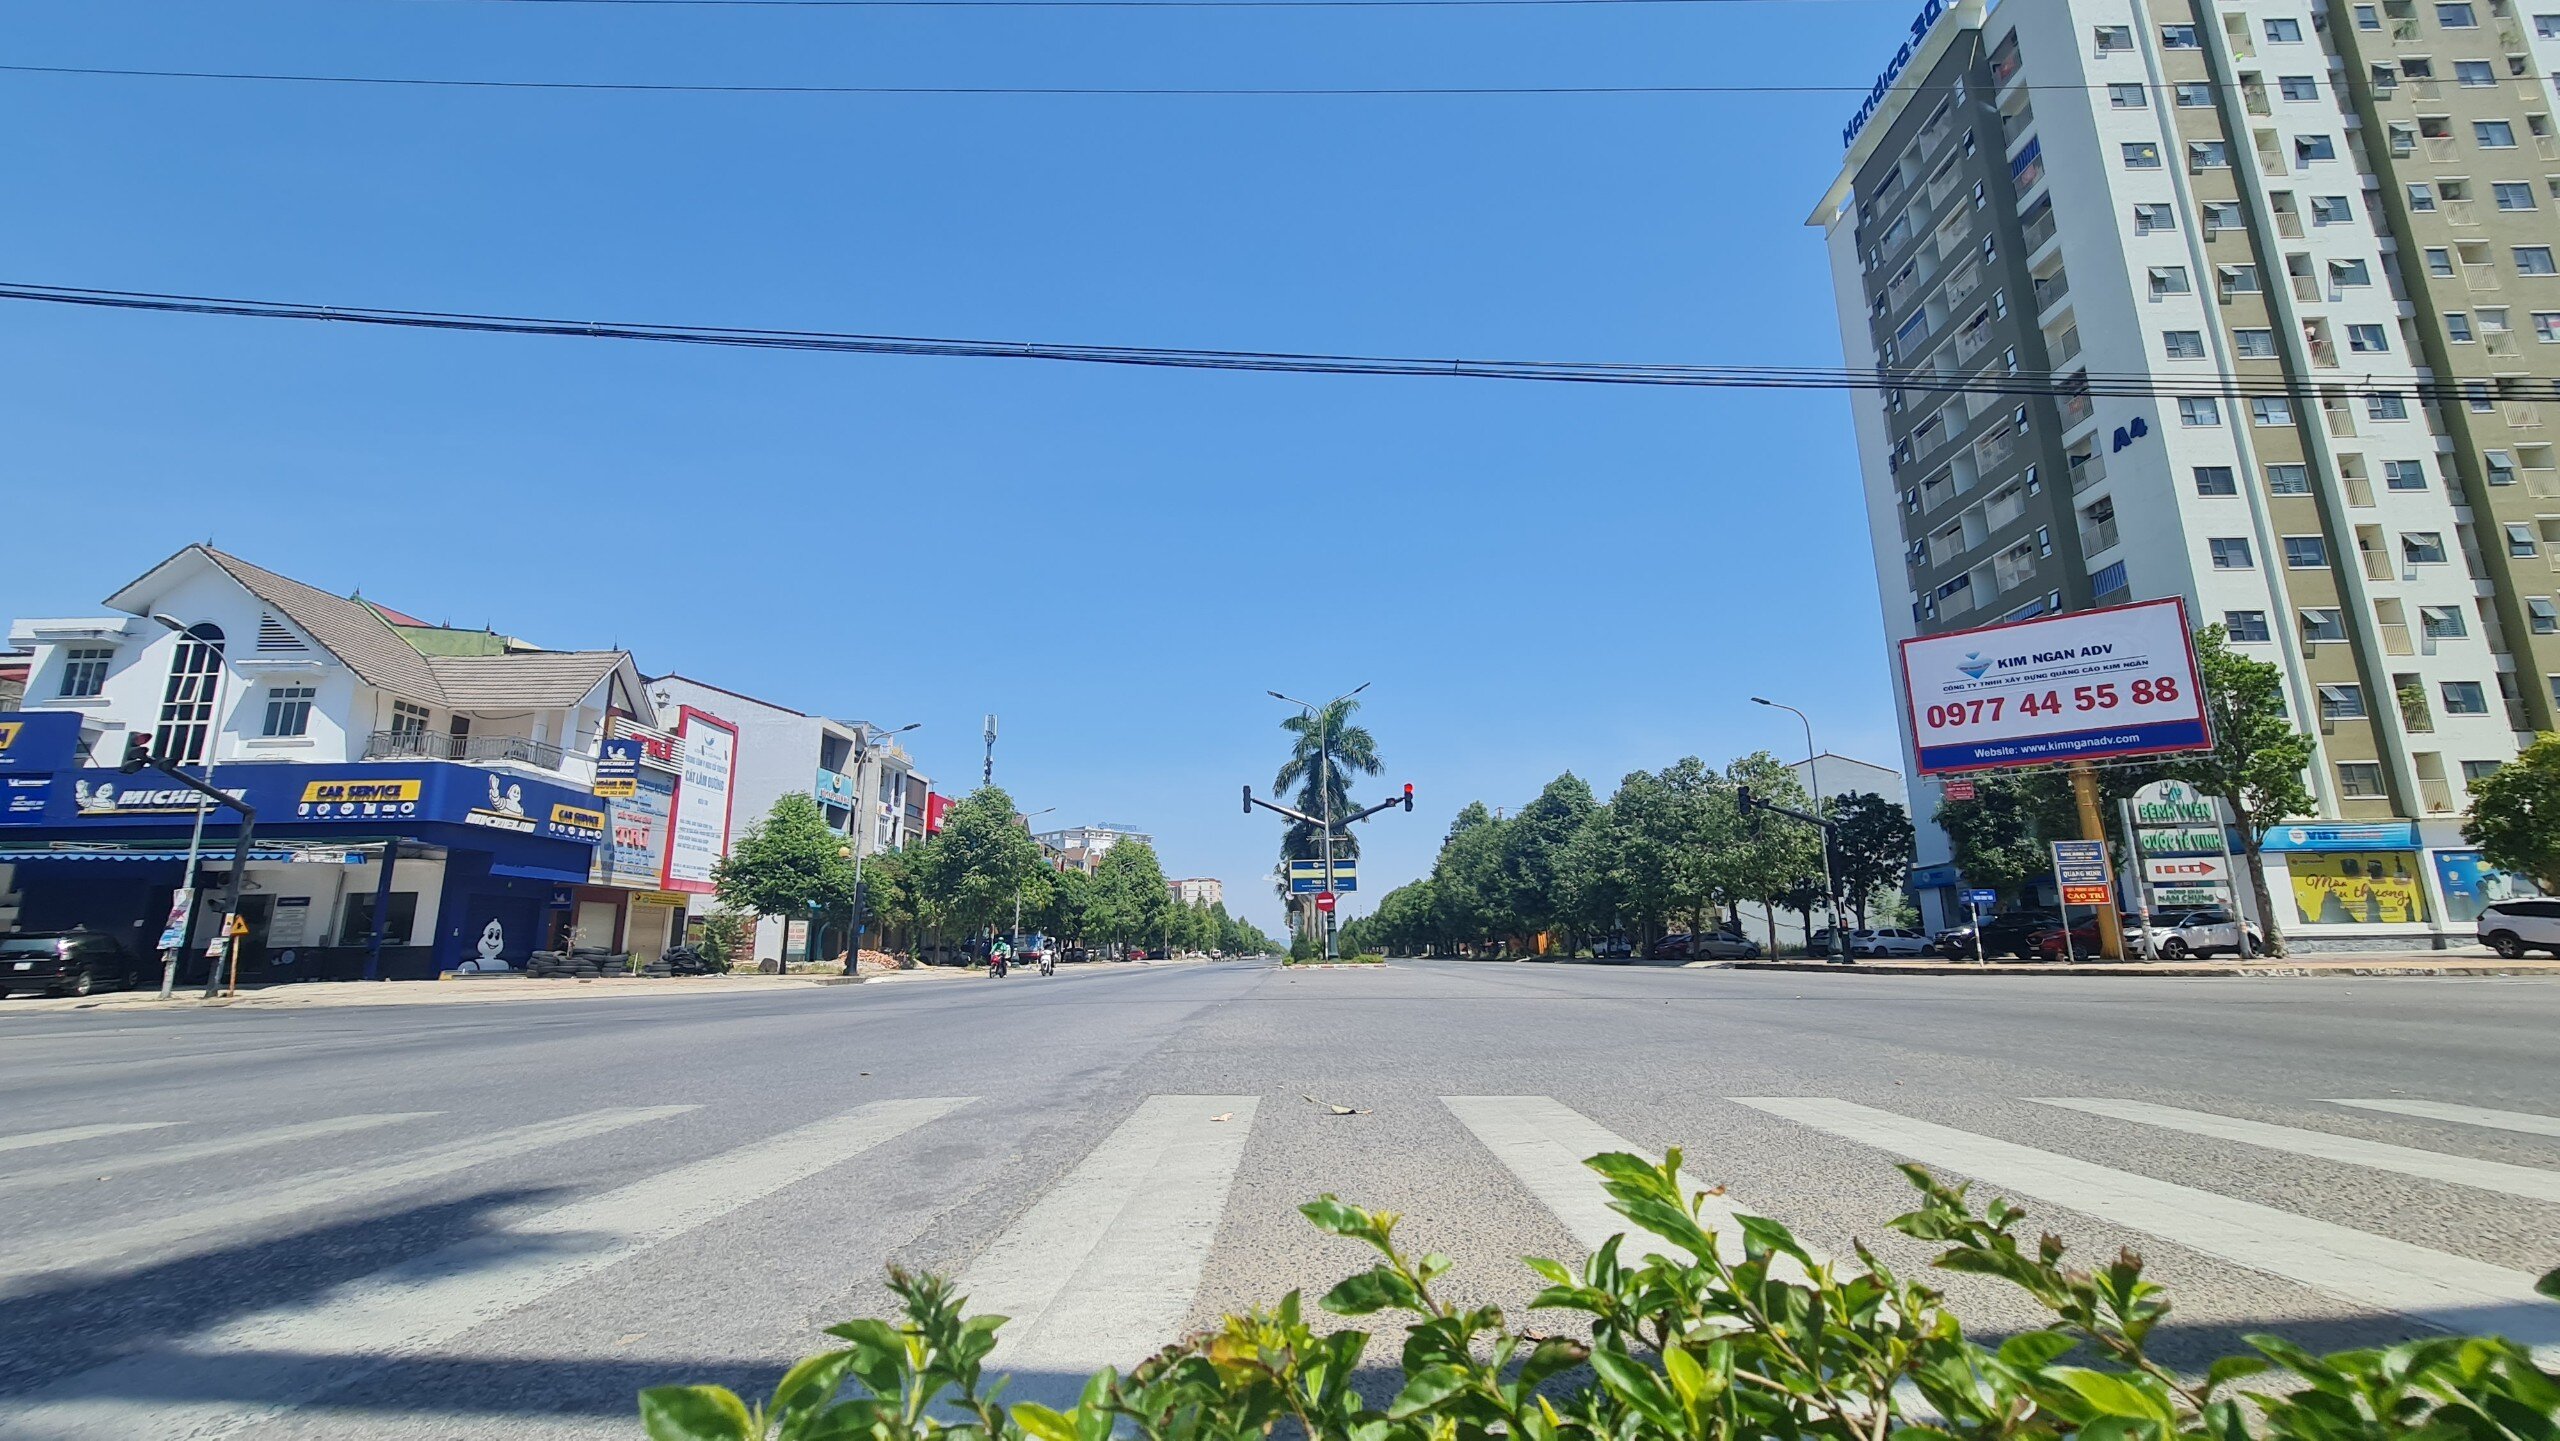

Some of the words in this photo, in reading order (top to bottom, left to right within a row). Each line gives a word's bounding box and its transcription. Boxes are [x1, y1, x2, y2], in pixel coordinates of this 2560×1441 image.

[2113, 416, 2148, 453] A4
[1997, 655, 2028, 669] KIM
[2032, 648, 2075, 664] NGAN
[2080, 643, 2113, 657] ADV
[1942, 684, 1965, 692] CÔNG
[1980, 679, 2002, 688] TNHH
[2102, 663, 2121, 671] KIM
[1927, 697, 2005, 728] 0977
[2019, 690, 2062, 717] 44
[2074, 683, 2119, 711] 55
[2131, 676, 2179, 704] 88
[1974, 746, 2018, 758] Website:
[2020, 733, 2141, 753] www.kimnganadv.com
[317, 785, 345, 798] CAR
[347, 785, 402, 798] SERVICE
[464, 812, 537, 833] MICHELIN
[558, 808, 573, 821] CAR
[574, 811, 600, 826] SERVICE
[2190, 833, 2222, 850] VINH
[2181, 894, 2214, 902] CHUNG
